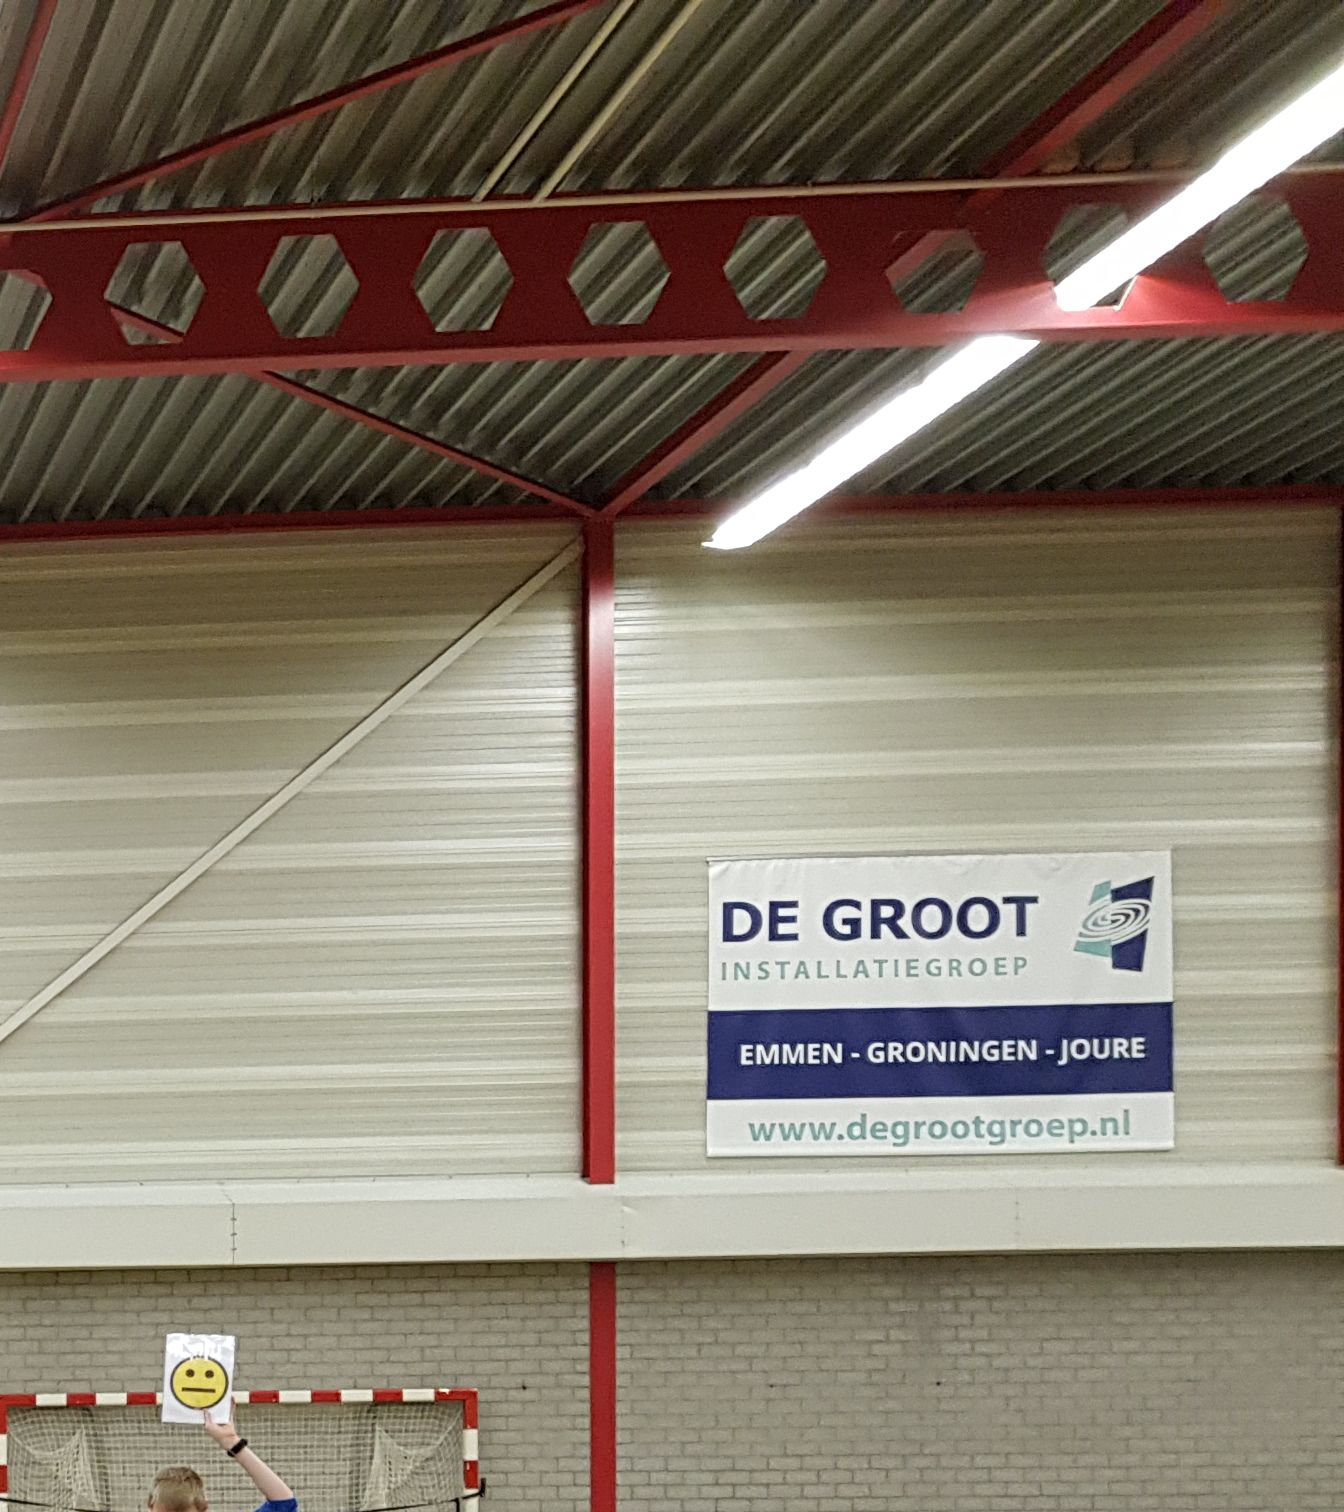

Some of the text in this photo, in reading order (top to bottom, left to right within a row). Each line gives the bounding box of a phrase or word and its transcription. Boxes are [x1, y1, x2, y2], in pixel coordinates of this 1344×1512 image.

[722, 896, 1039, 942] DE GROOT
[721, 957, 1028, 981] INSTALLATIEGROEP
[740, 1043, 843, 1066] EMMEN
[867, 1039, 1038, 1064] GRONINGEN
[1058, 1037, 1146, 1066] JOURE
[749, 1109, 1131, 1148] www.degrootgroep.nl
